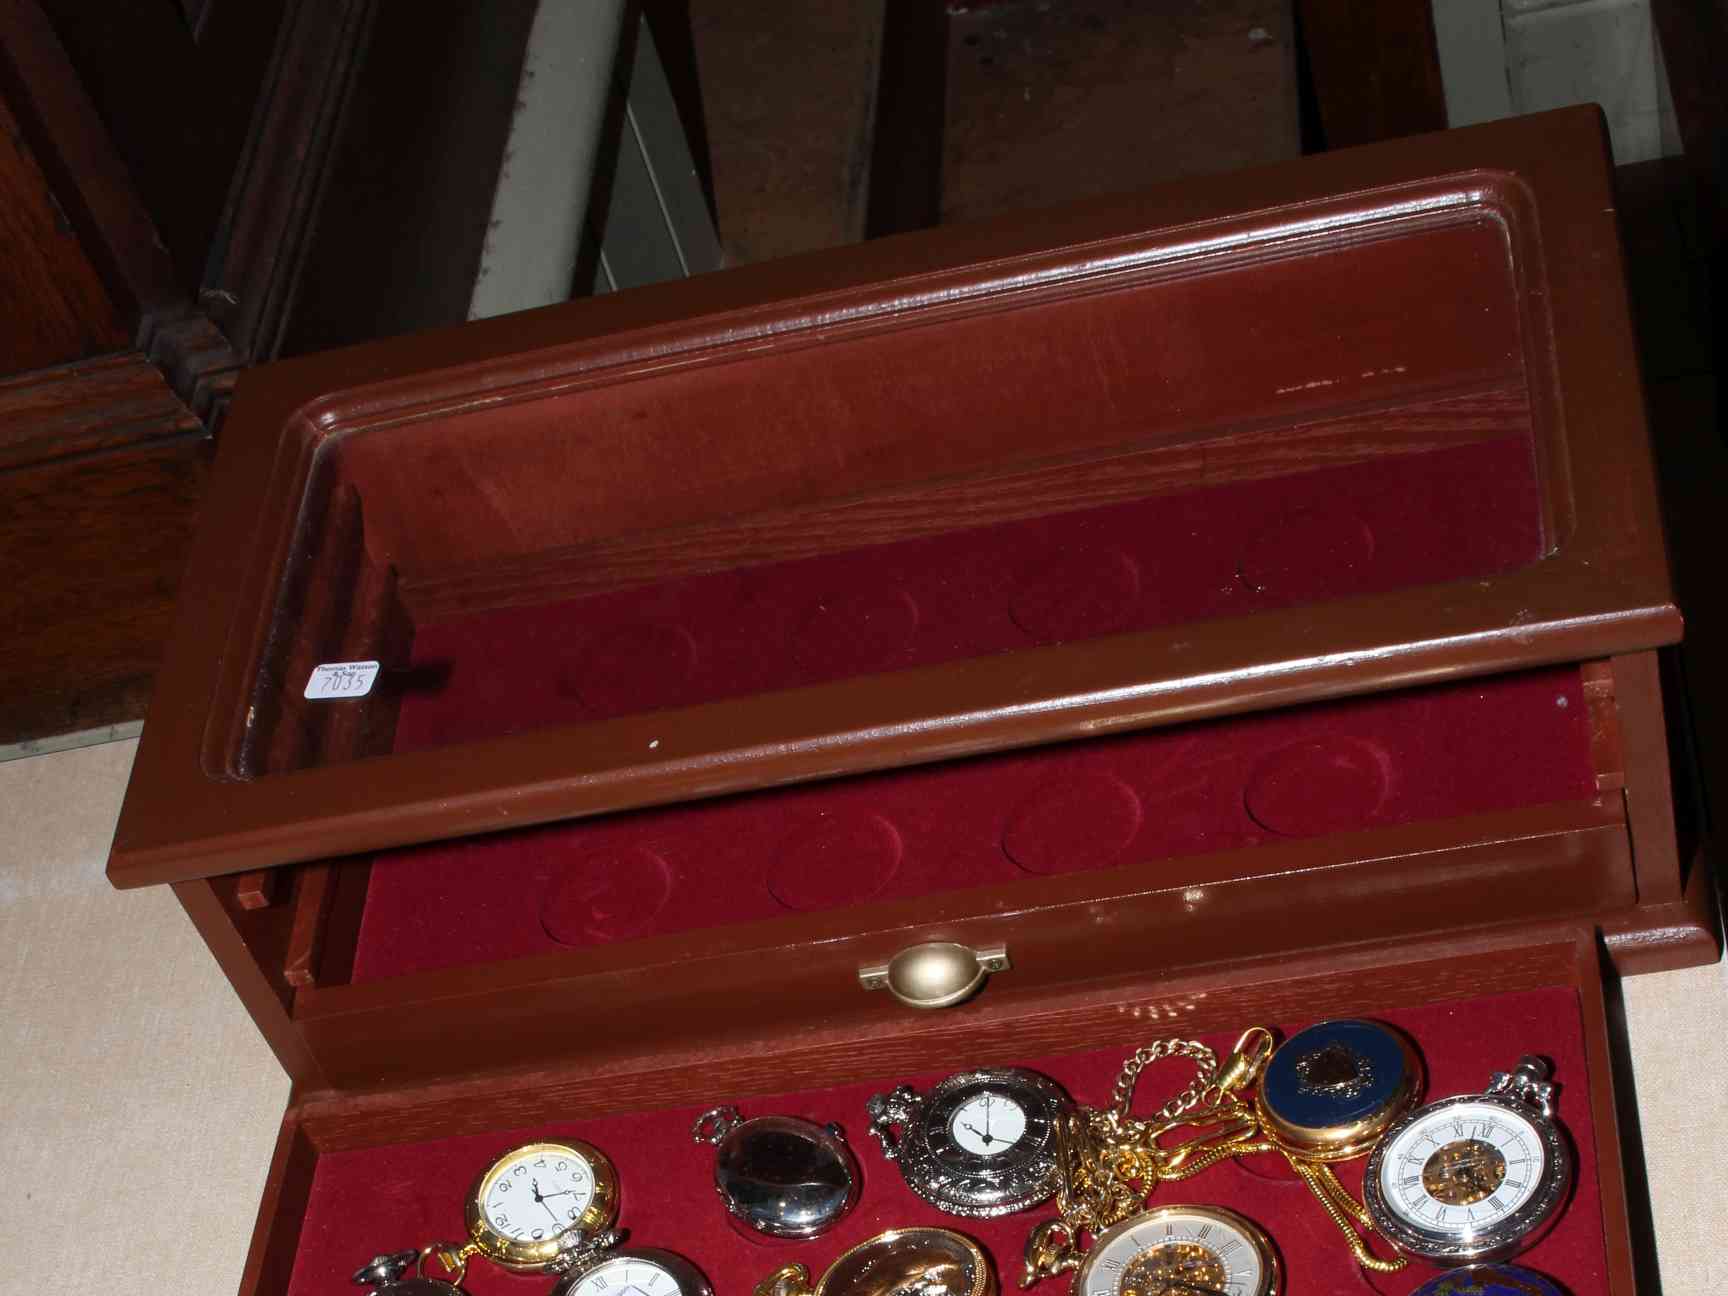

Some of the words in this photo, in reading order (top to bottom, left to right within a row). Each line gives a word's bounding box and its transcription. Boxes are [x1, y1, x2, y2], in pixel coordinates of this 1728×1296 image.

[320, 673, 368, 693] 7035
[513, 1166, 527, 1176] 3
[567, 1206, 581, 1221] 8
